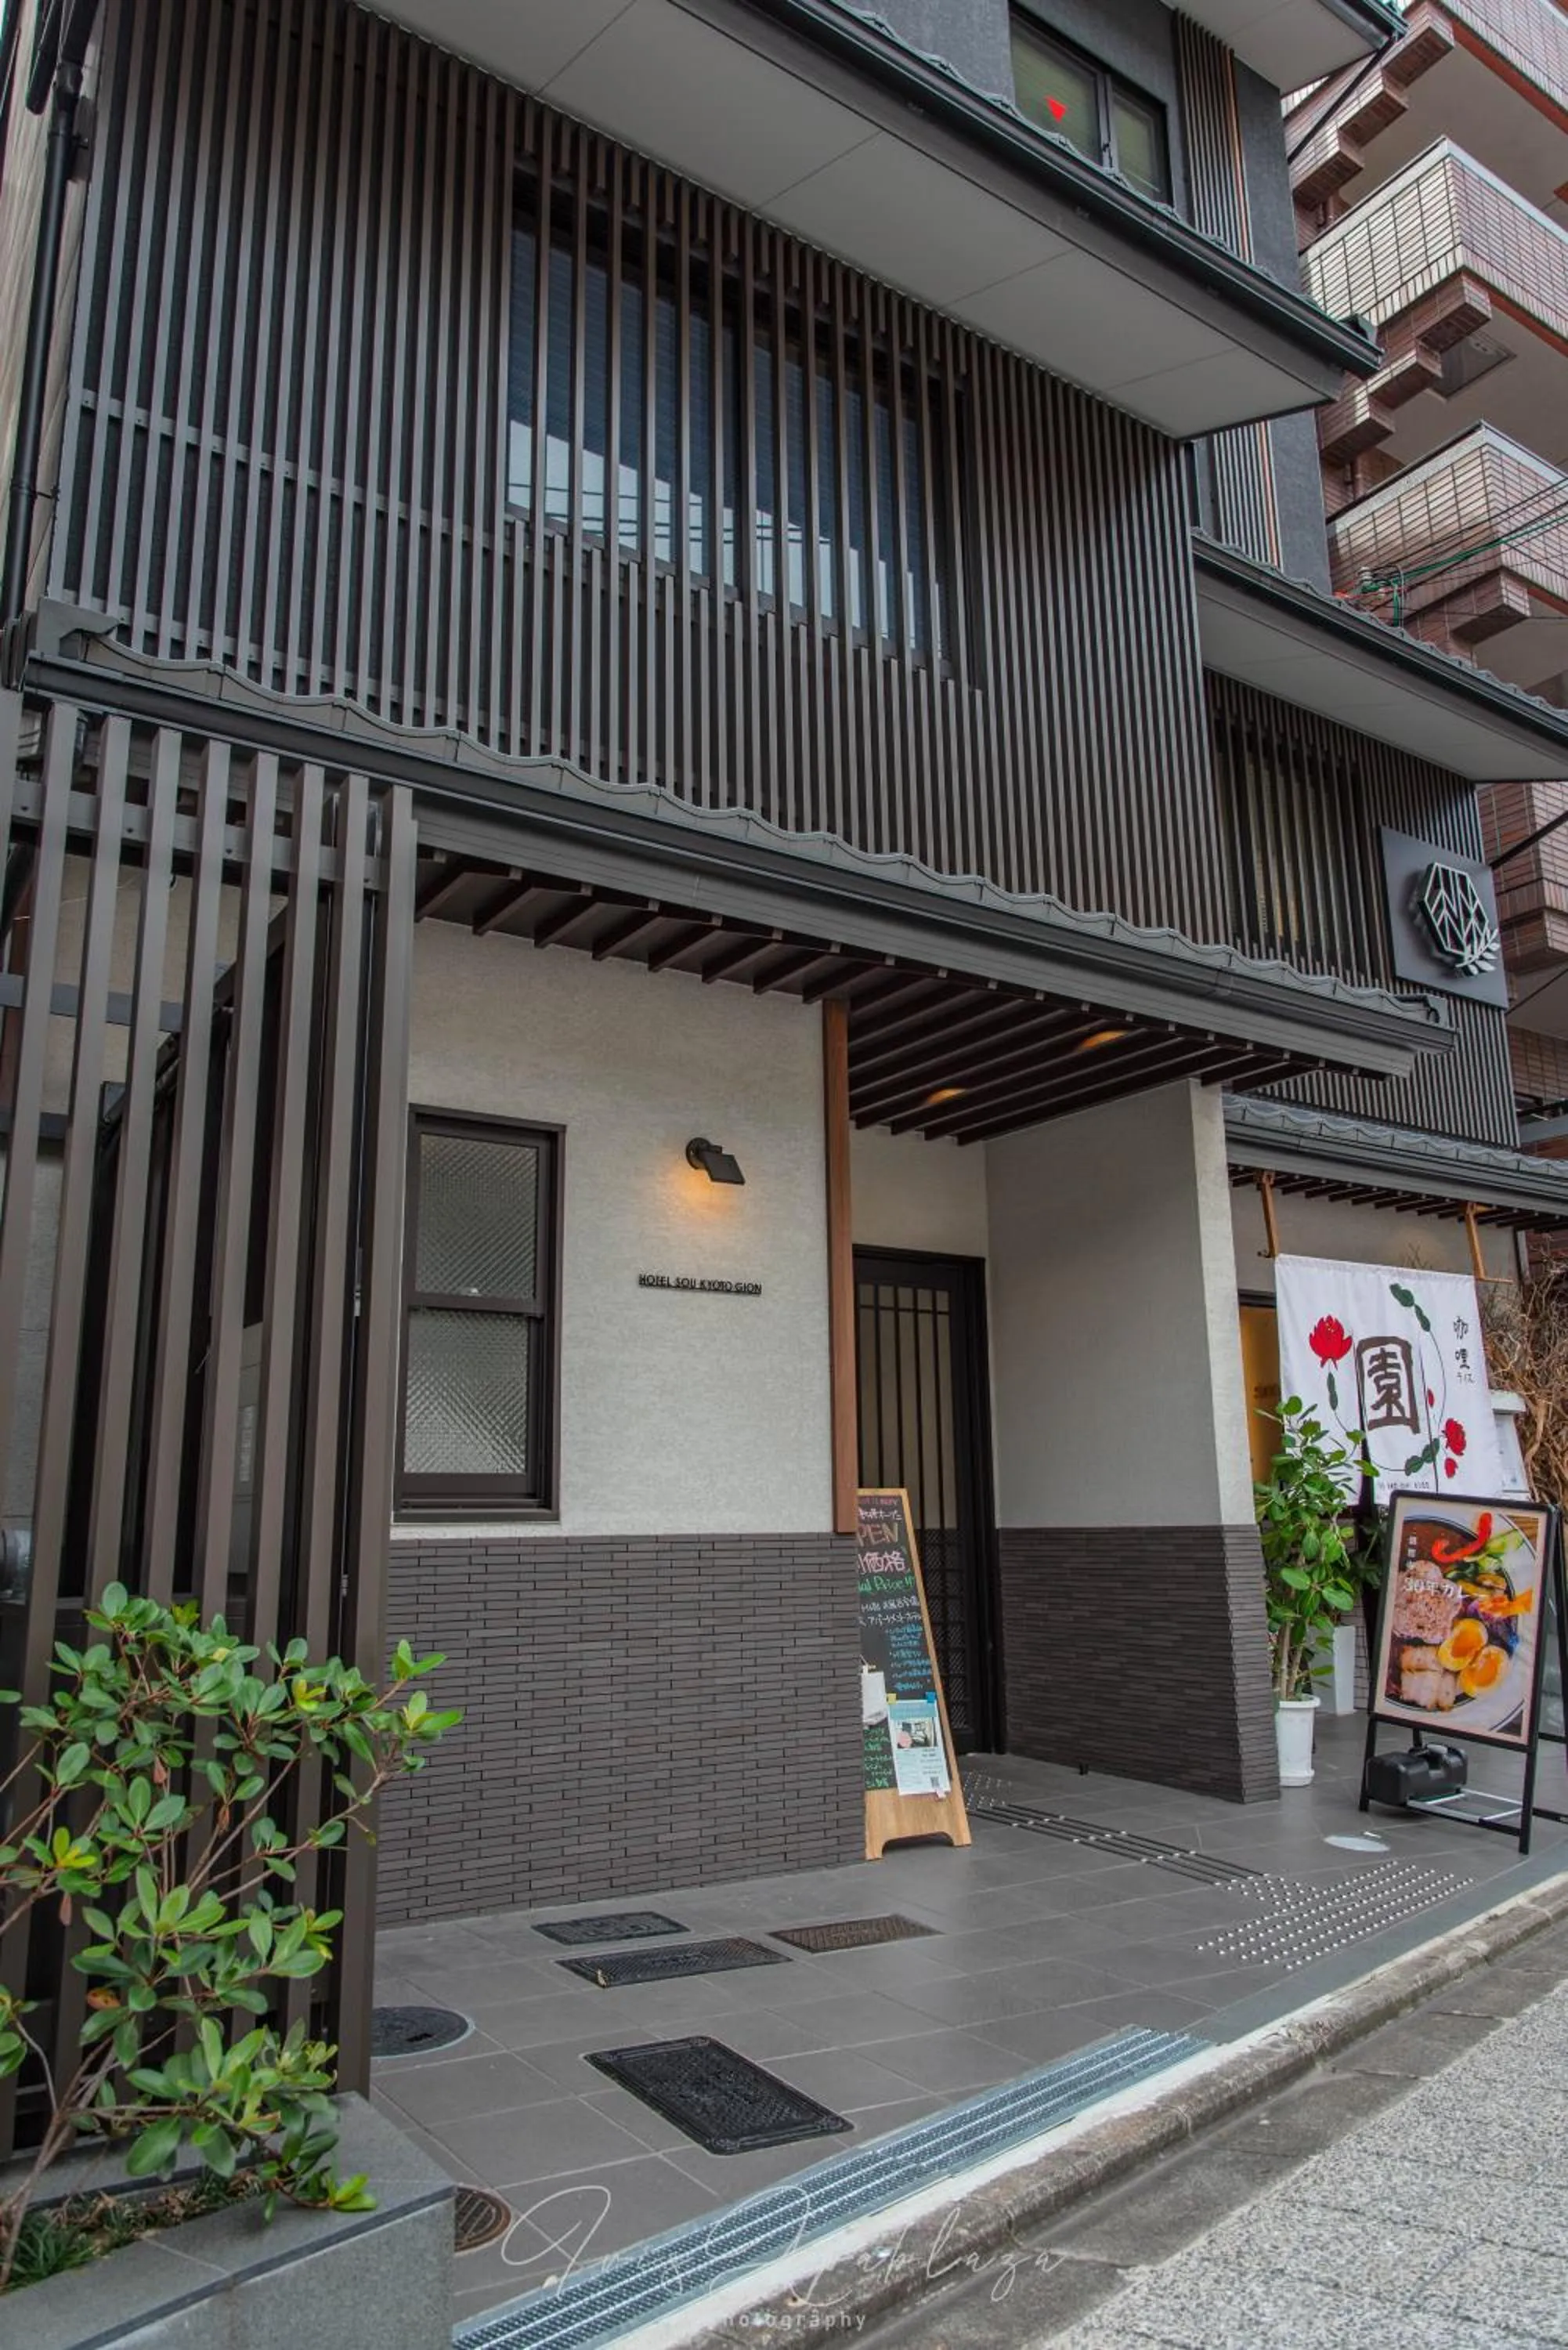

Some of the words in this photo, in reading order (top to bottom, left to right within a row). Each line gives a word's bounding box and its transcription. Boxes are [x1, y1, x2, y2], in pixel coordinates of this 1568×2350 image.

[638, 1274, 670, 1288] HOTEL
[676, 1277, 696, 1289] SOU
[700, 1278, 732, 1292] KYOTO
[735, 1282, 762, 1294] GION
